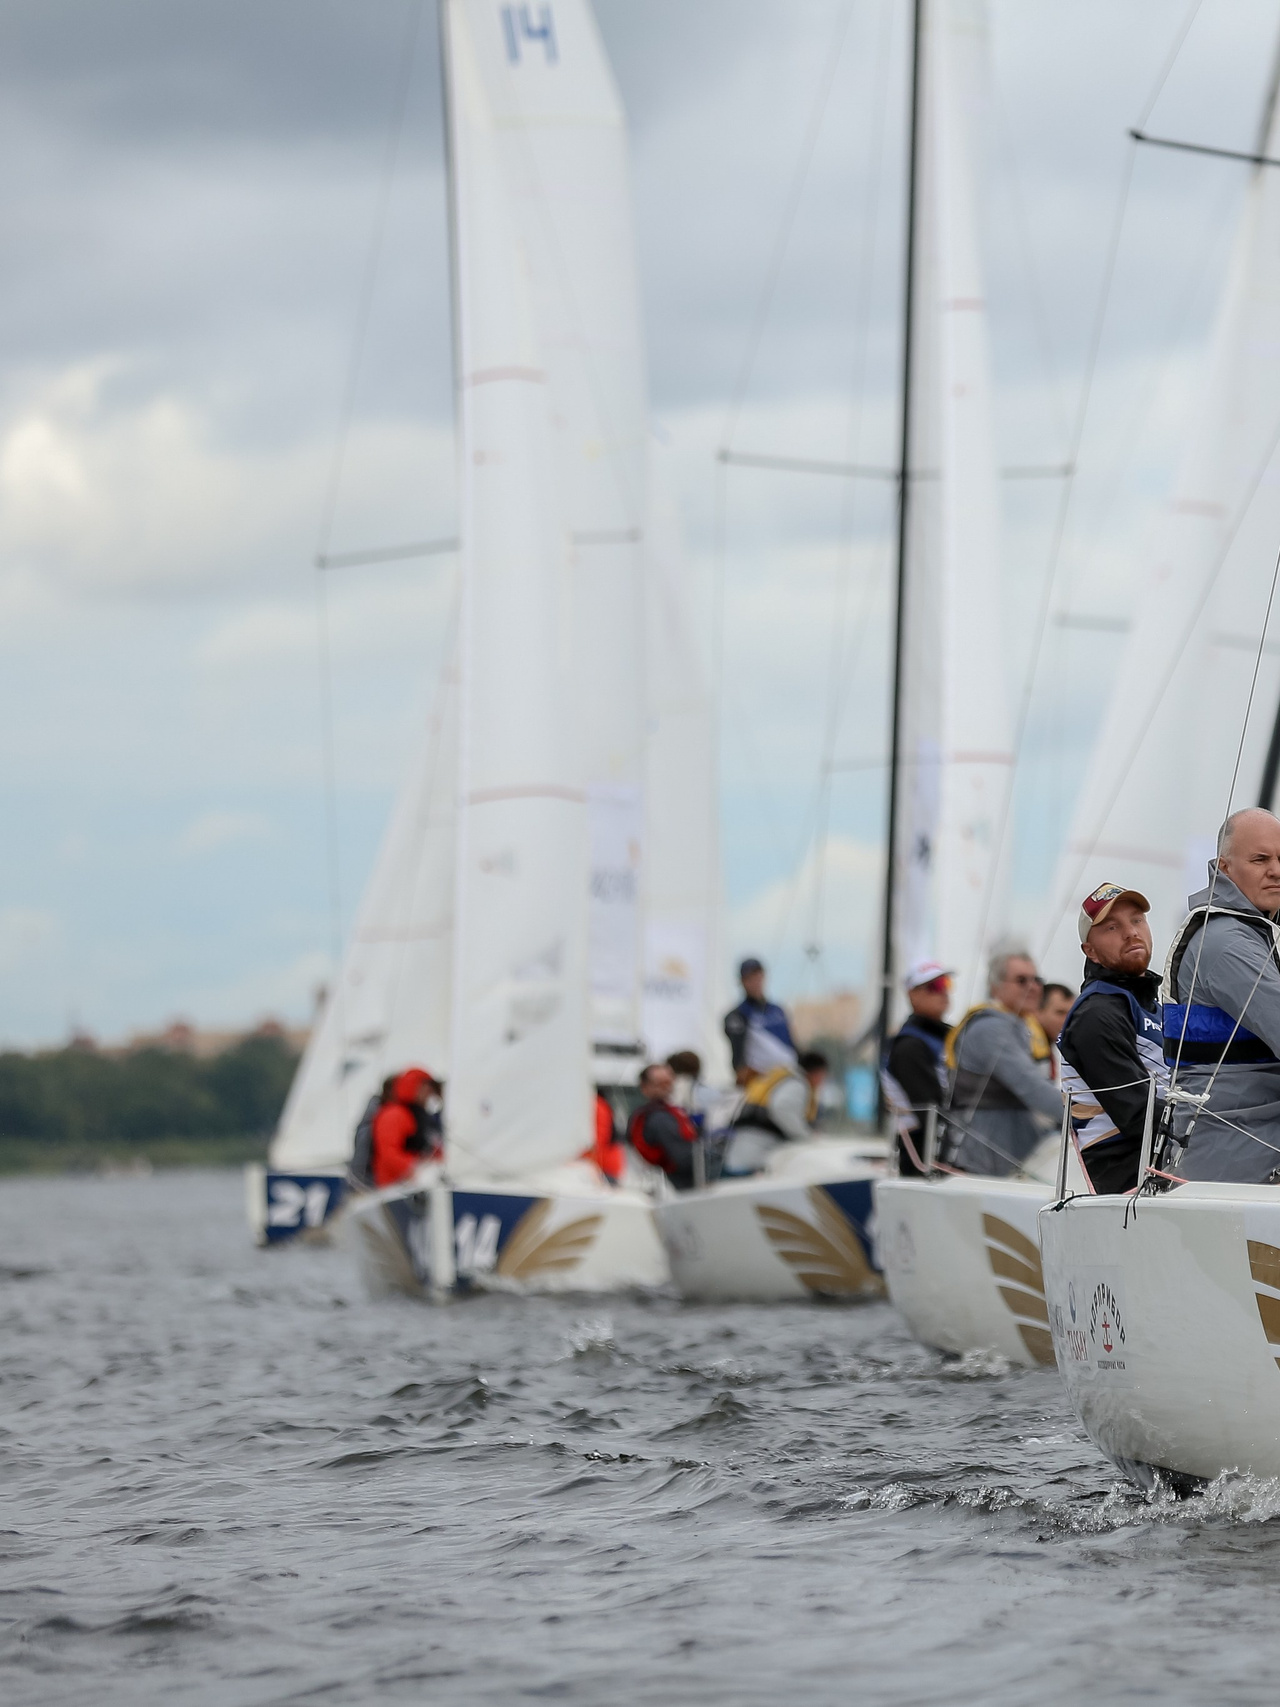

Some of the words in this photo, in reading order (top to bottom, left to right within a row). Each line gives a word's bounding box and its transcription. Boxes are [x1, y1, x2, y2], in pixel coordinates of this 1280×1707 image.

[500, 3, 560, 66] 14
[268, 1180, 331, 1228] 21
[454, 1213, 502, 1270] 14
